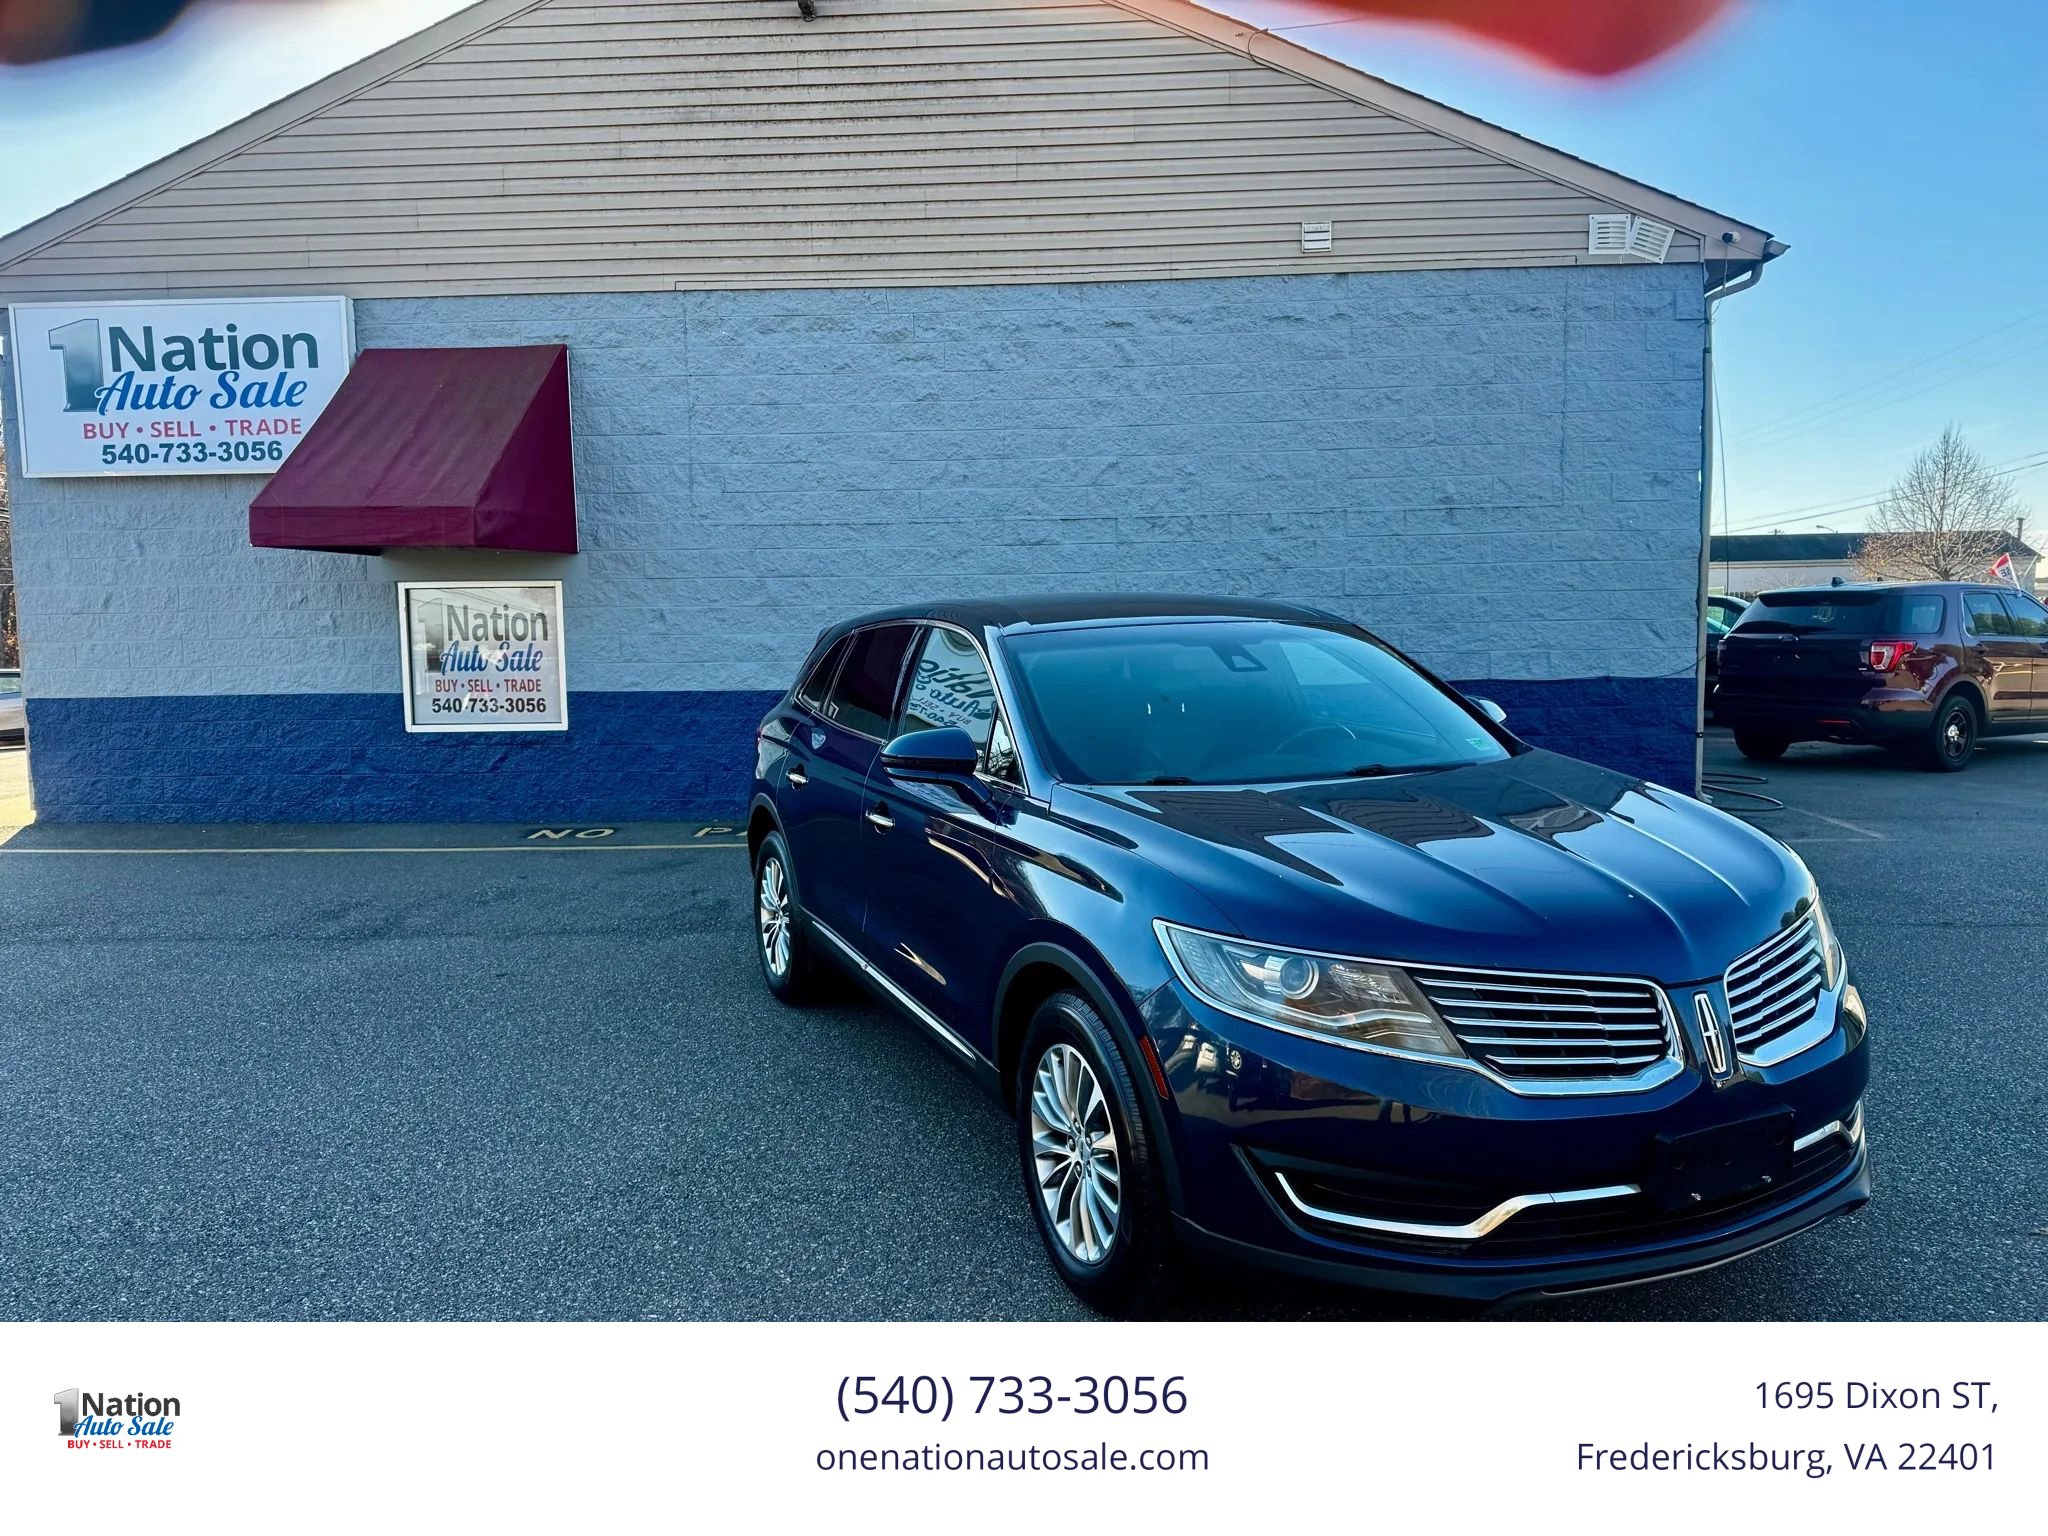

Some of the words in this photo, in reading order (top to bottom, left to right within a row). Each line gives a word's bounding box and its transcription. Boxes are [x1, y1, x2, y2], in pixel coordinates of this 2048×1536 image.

[48, 318, 104, 412] 1
[108, 323, 319, 373] Nation
[96, 371, 202, 416] Auto
[210, 370, 307, 409] Sale
[83, 422, 130, 439] BUY
[150, 420, 202, 438] SELL
[225, 418, 302, 436] TRADE
[101, 440, 283, 465] 540-733-3056
[418, 598, 444, 673] 1
[447, 604, 549, 641] Nation
[440, 640, 488, 676] Auto
[495, 641, 543, 672] Sale
[435, 679, 458, 692] BUY
[468, 679, 493, 692] SELL
[504, 679, 542, 692] TRADE
[527, 828, 615, 840] NO
